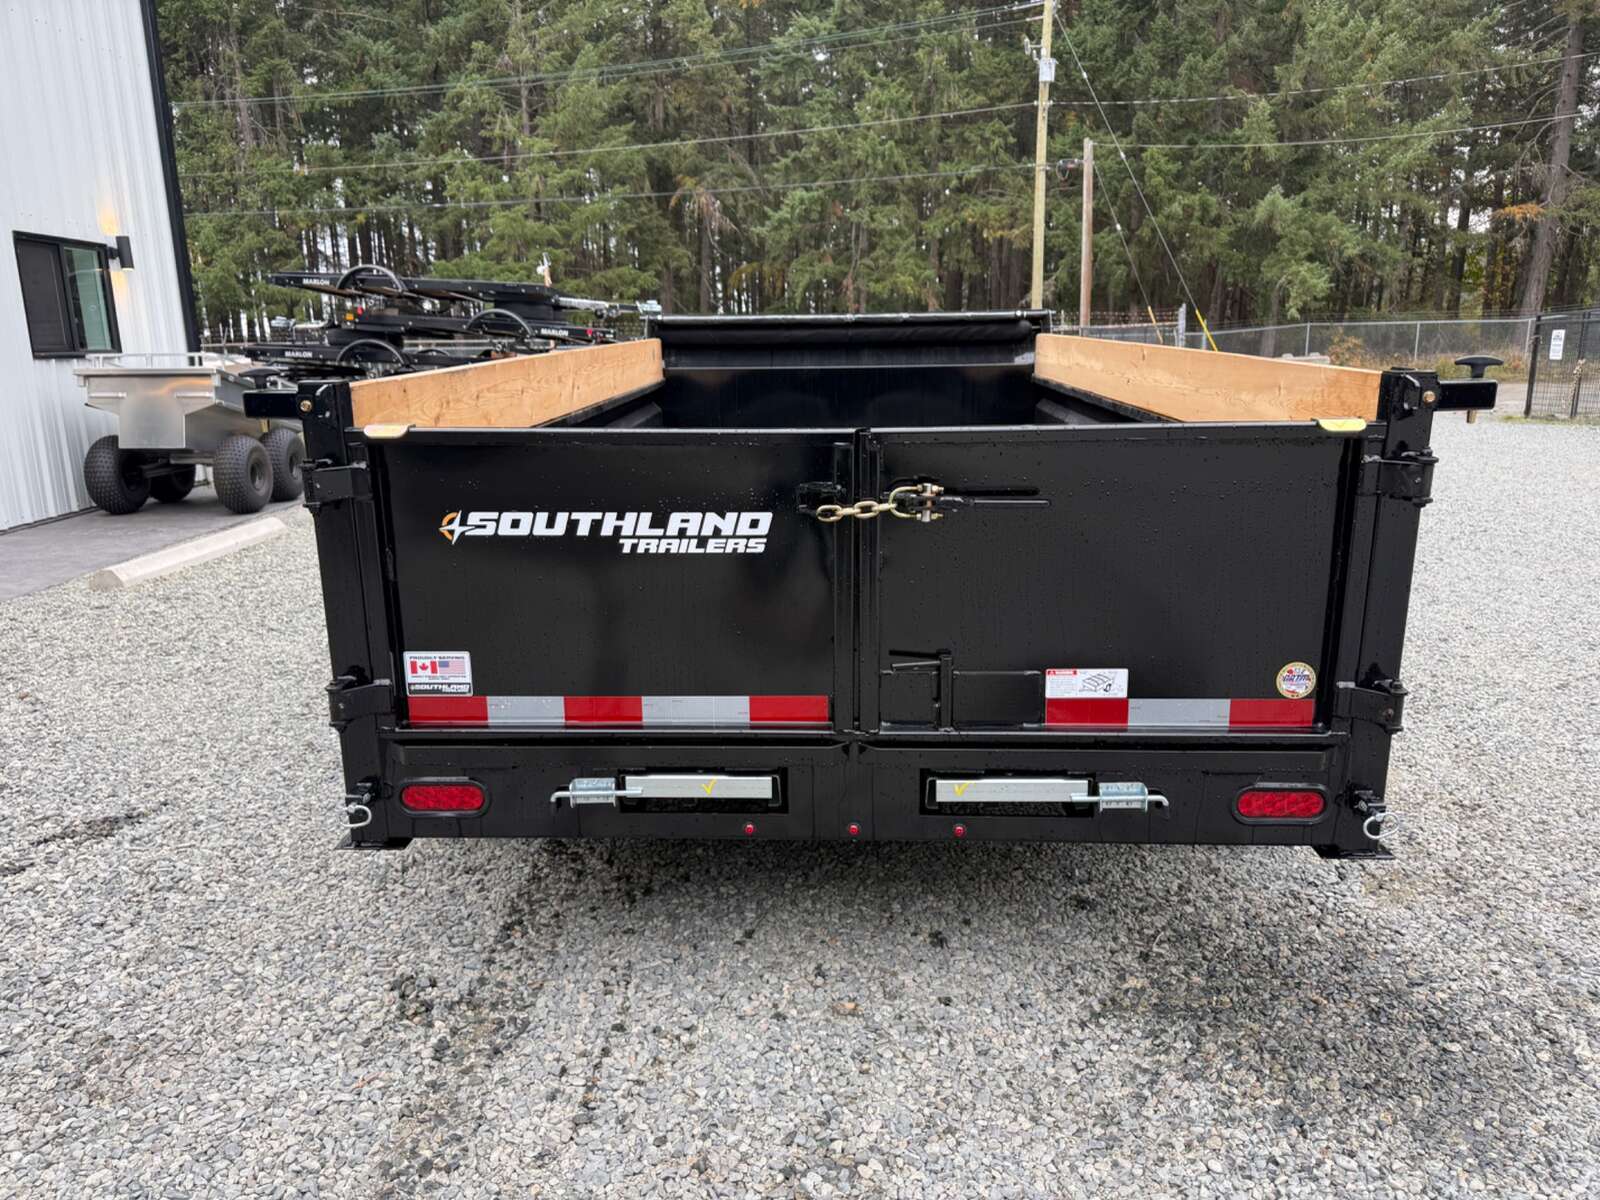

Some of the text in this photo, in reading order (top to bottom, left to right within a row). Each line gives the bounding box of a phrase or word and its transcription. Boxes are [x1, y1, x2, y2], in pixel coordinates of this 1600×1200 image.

[303, 278, 330, 286] MARLON
[541, 328, 569, 337] MARLON
[284, 350, 312, 358] MARLON
[464, 511, 774, 537] SOUTHLAND
[618, 538, 768, 554] TRAILERS
